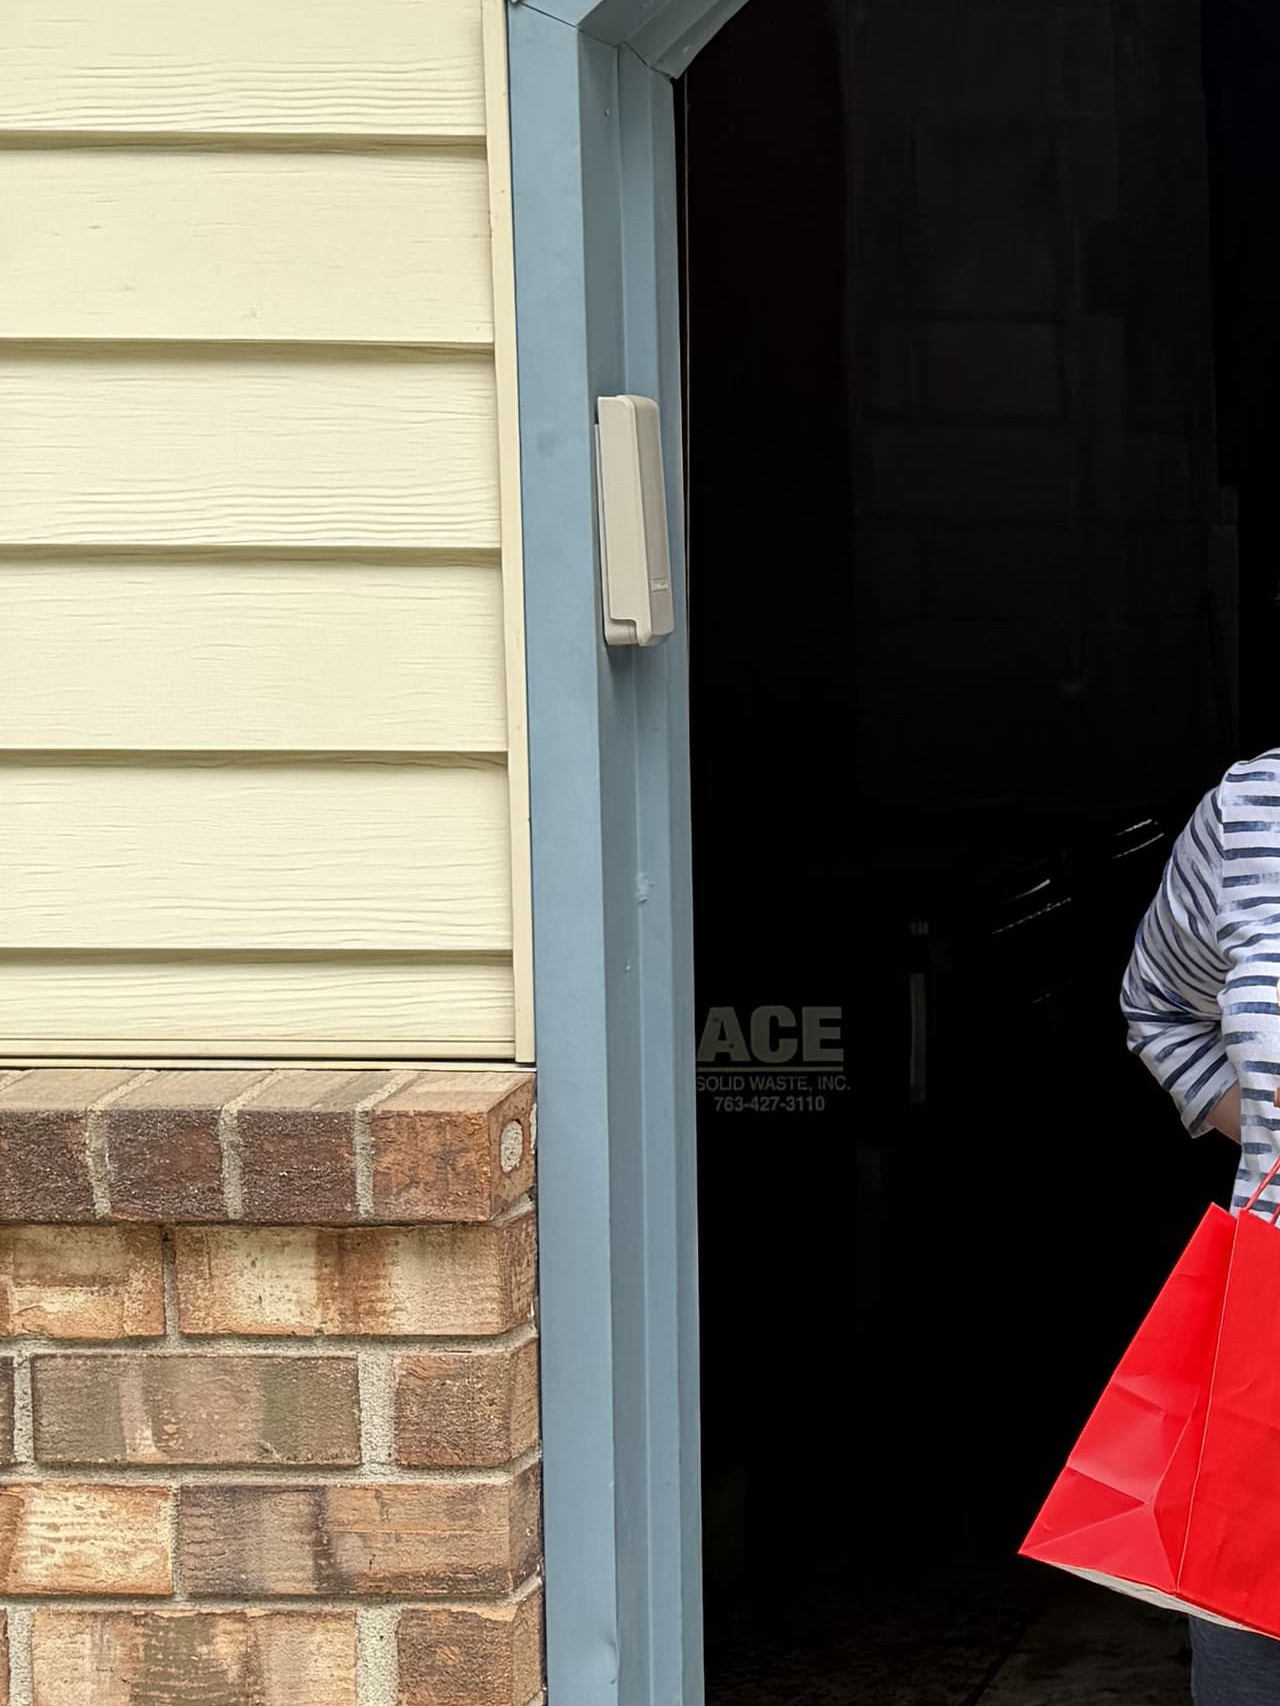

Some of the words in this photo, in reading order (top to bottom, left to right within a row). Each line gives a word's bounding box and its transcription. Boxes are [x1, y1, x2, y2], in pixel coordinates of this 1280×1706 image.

[696, 1005, 845, 1064] ACE
[696, 1076, 745, 1092] SOLID
[817, 1075, 852, 1092] INC.
[713, 1096, 826, 1113] 763-427-3110
